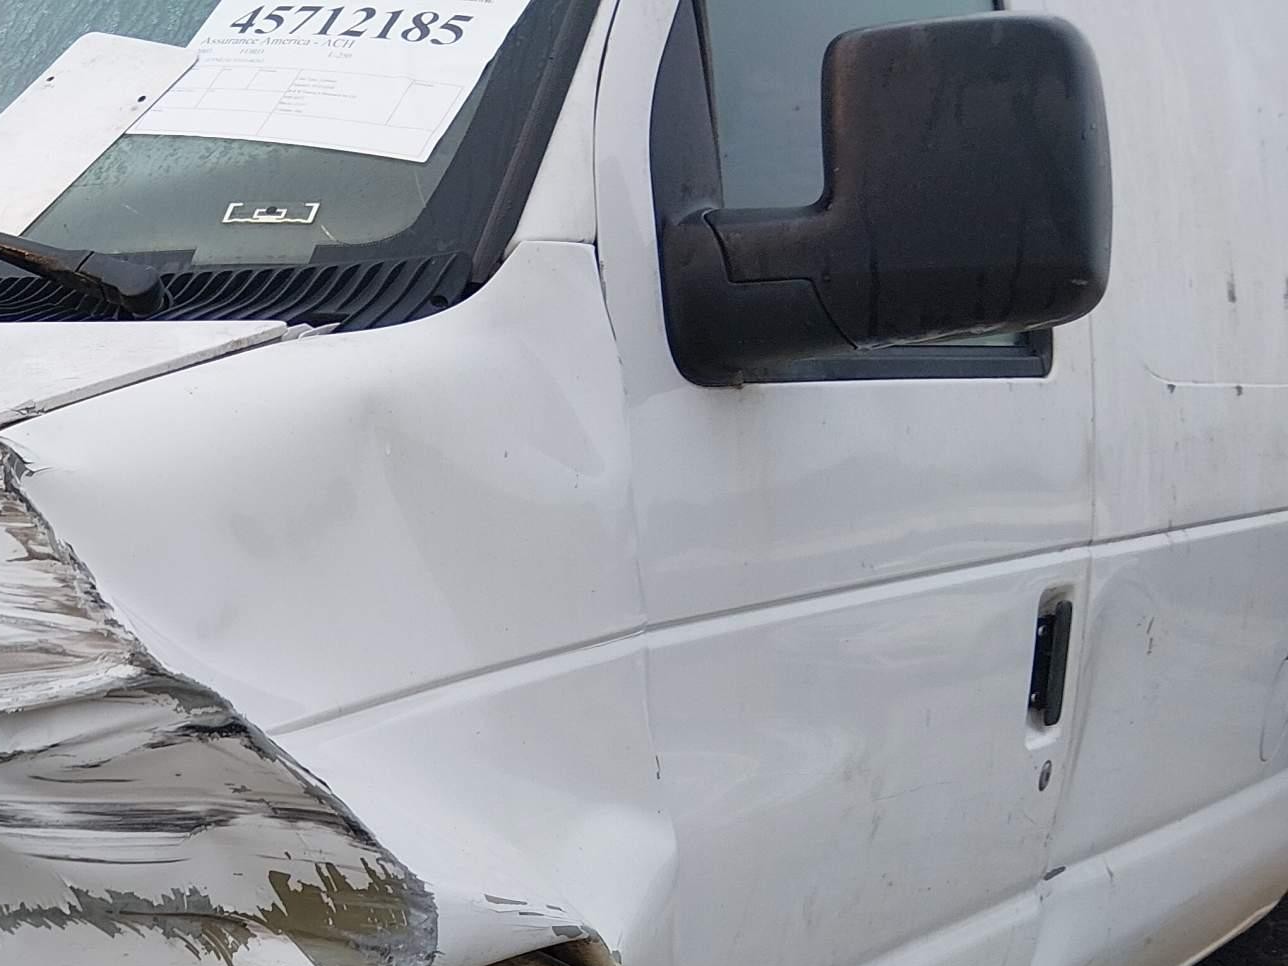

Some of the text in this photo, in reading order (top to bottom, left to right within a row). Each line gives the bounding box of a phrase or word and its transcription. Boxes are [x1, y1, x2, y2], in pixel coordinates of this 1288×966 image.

[229, 4, 475, 45] 45712185
[200, 36, 259, 47] Assurance
[261, 36, 311, 48] America
[320, 39, 357, 49] ACH
